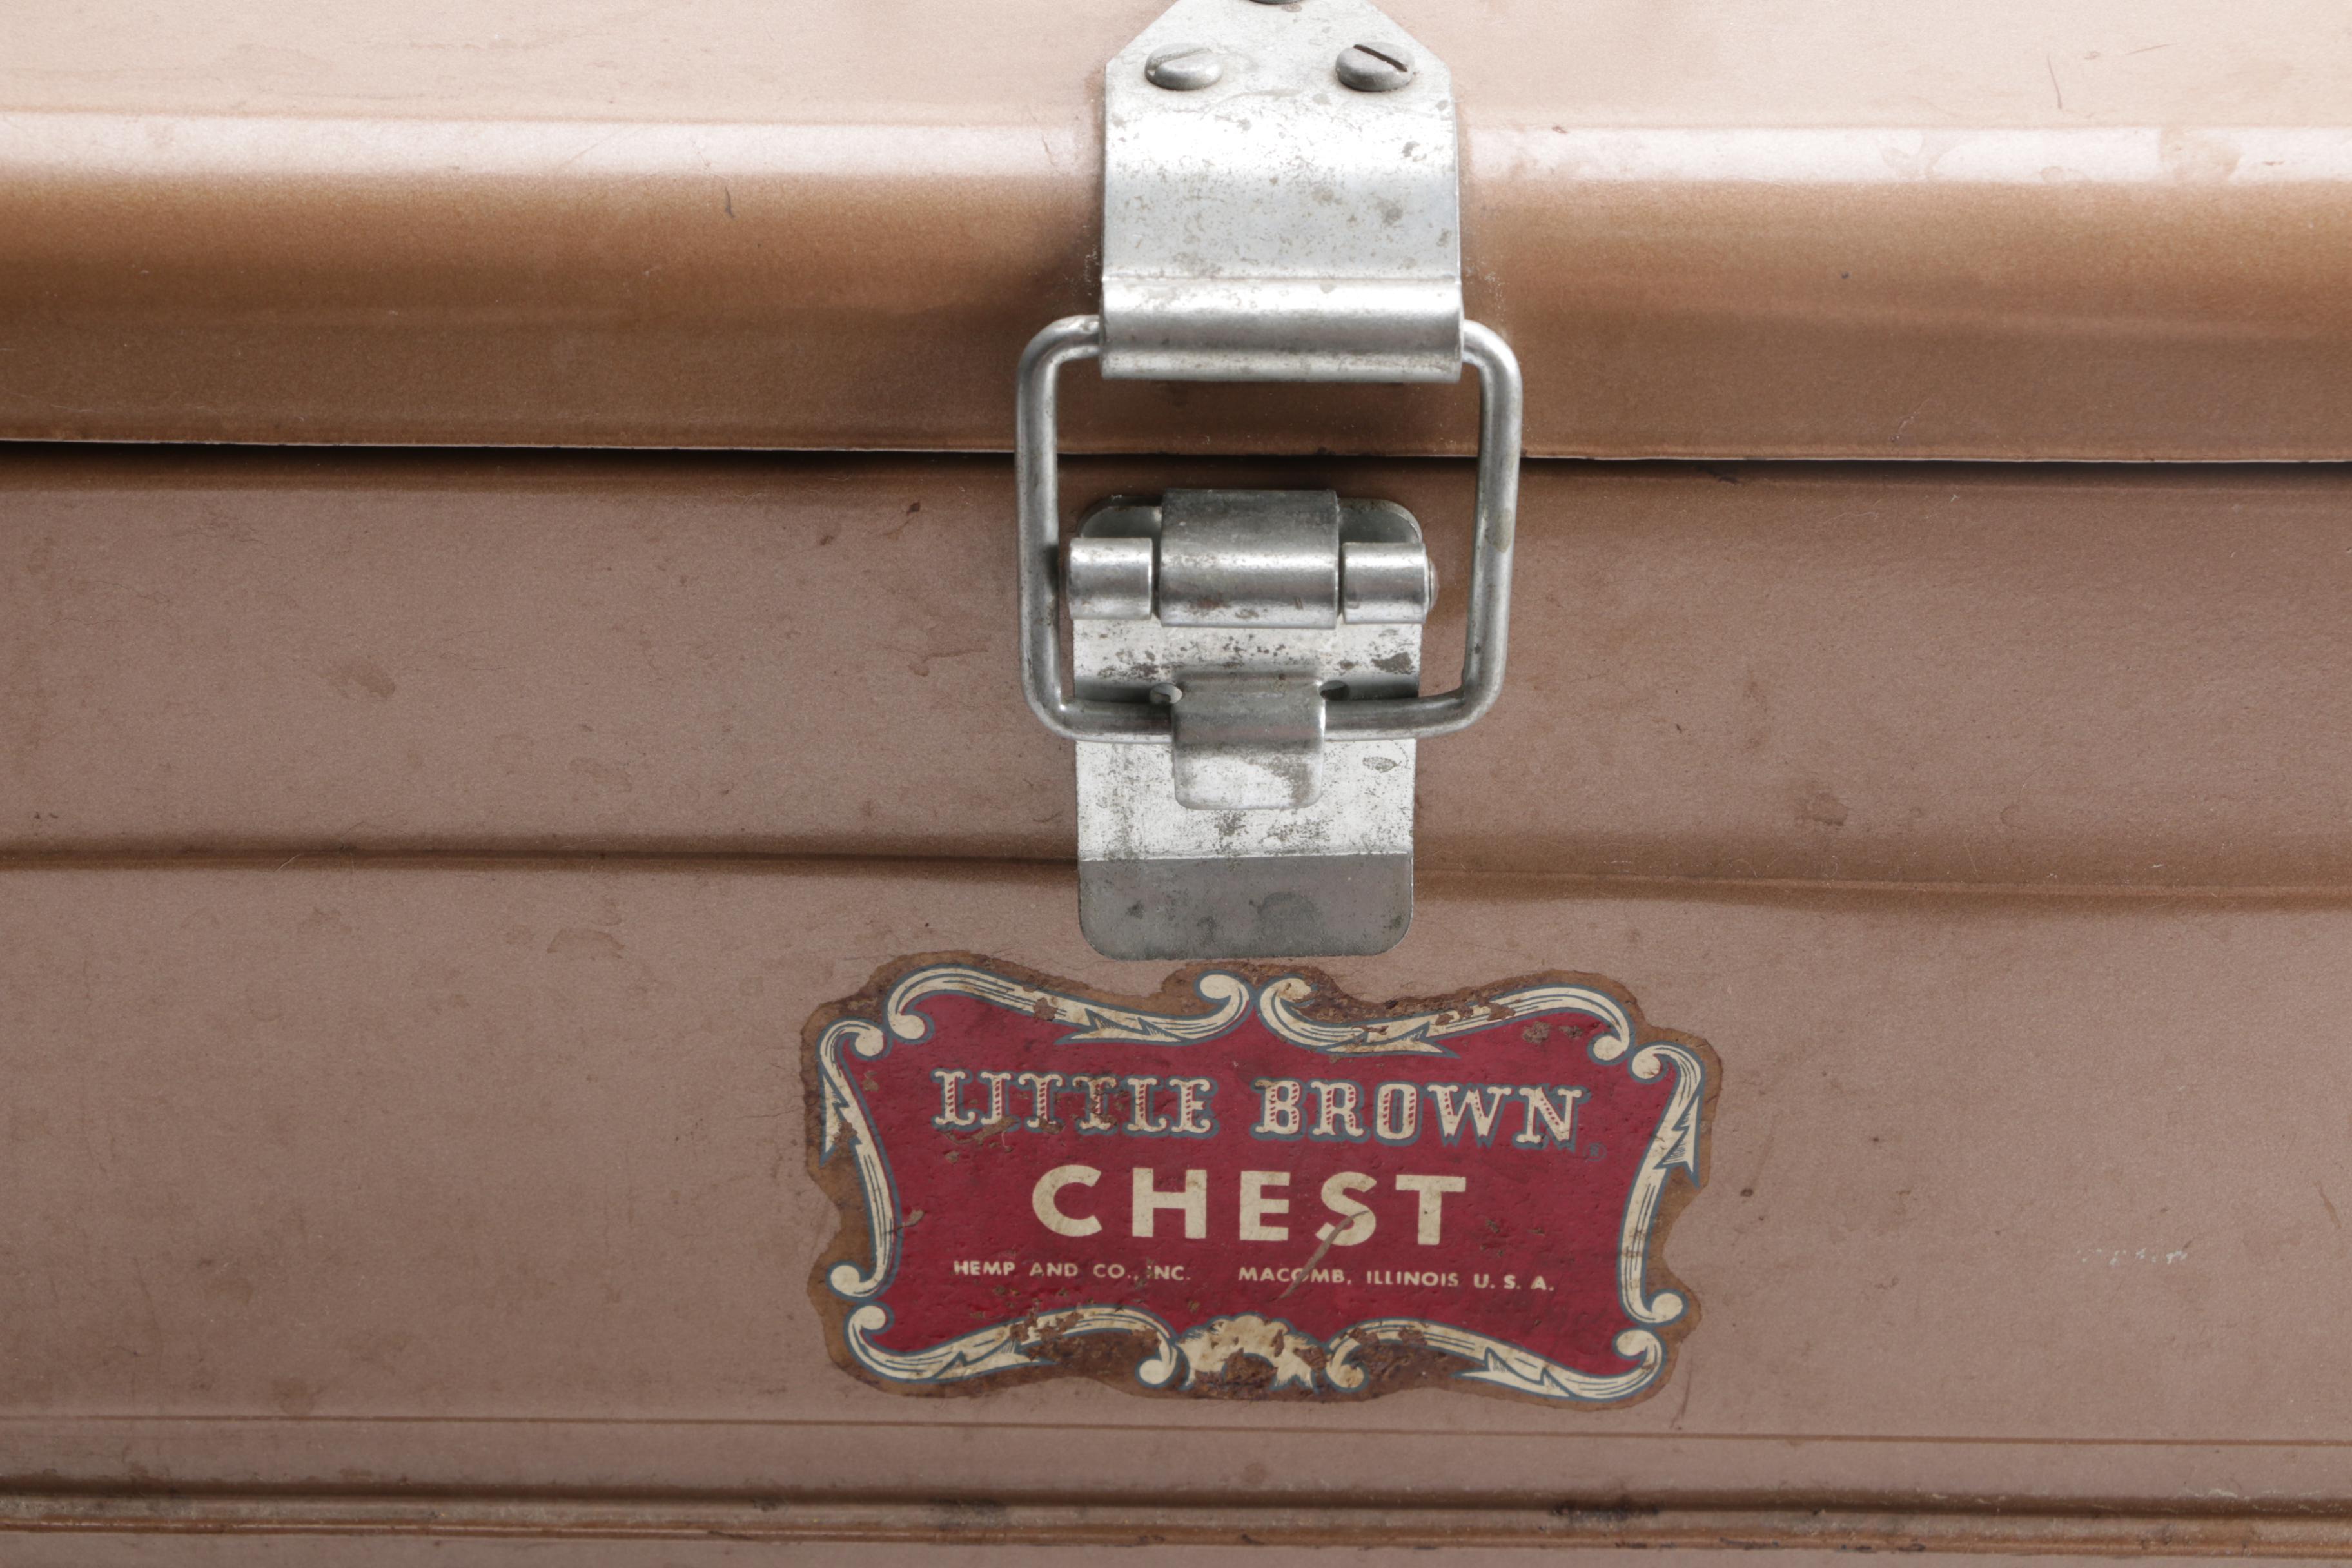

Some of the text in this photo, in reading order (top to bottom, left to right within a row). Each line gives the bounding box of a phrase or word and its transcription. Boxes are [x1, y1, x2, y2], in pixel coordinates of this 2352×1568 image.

[932, 1069, 1215, 1136] LITTLE
[1252, 1079, 1583, 1150] BROWN
[1032, 1164, 1467, 1246] CHEST
[954, 1260, 1015, 1277] HEMP
[1029, 1262, 1079, 1277] AND
[1238, 1266, 1352, 1286] MACOMB,
[1366, 1270, 1460, 1288] ILLINOIS
